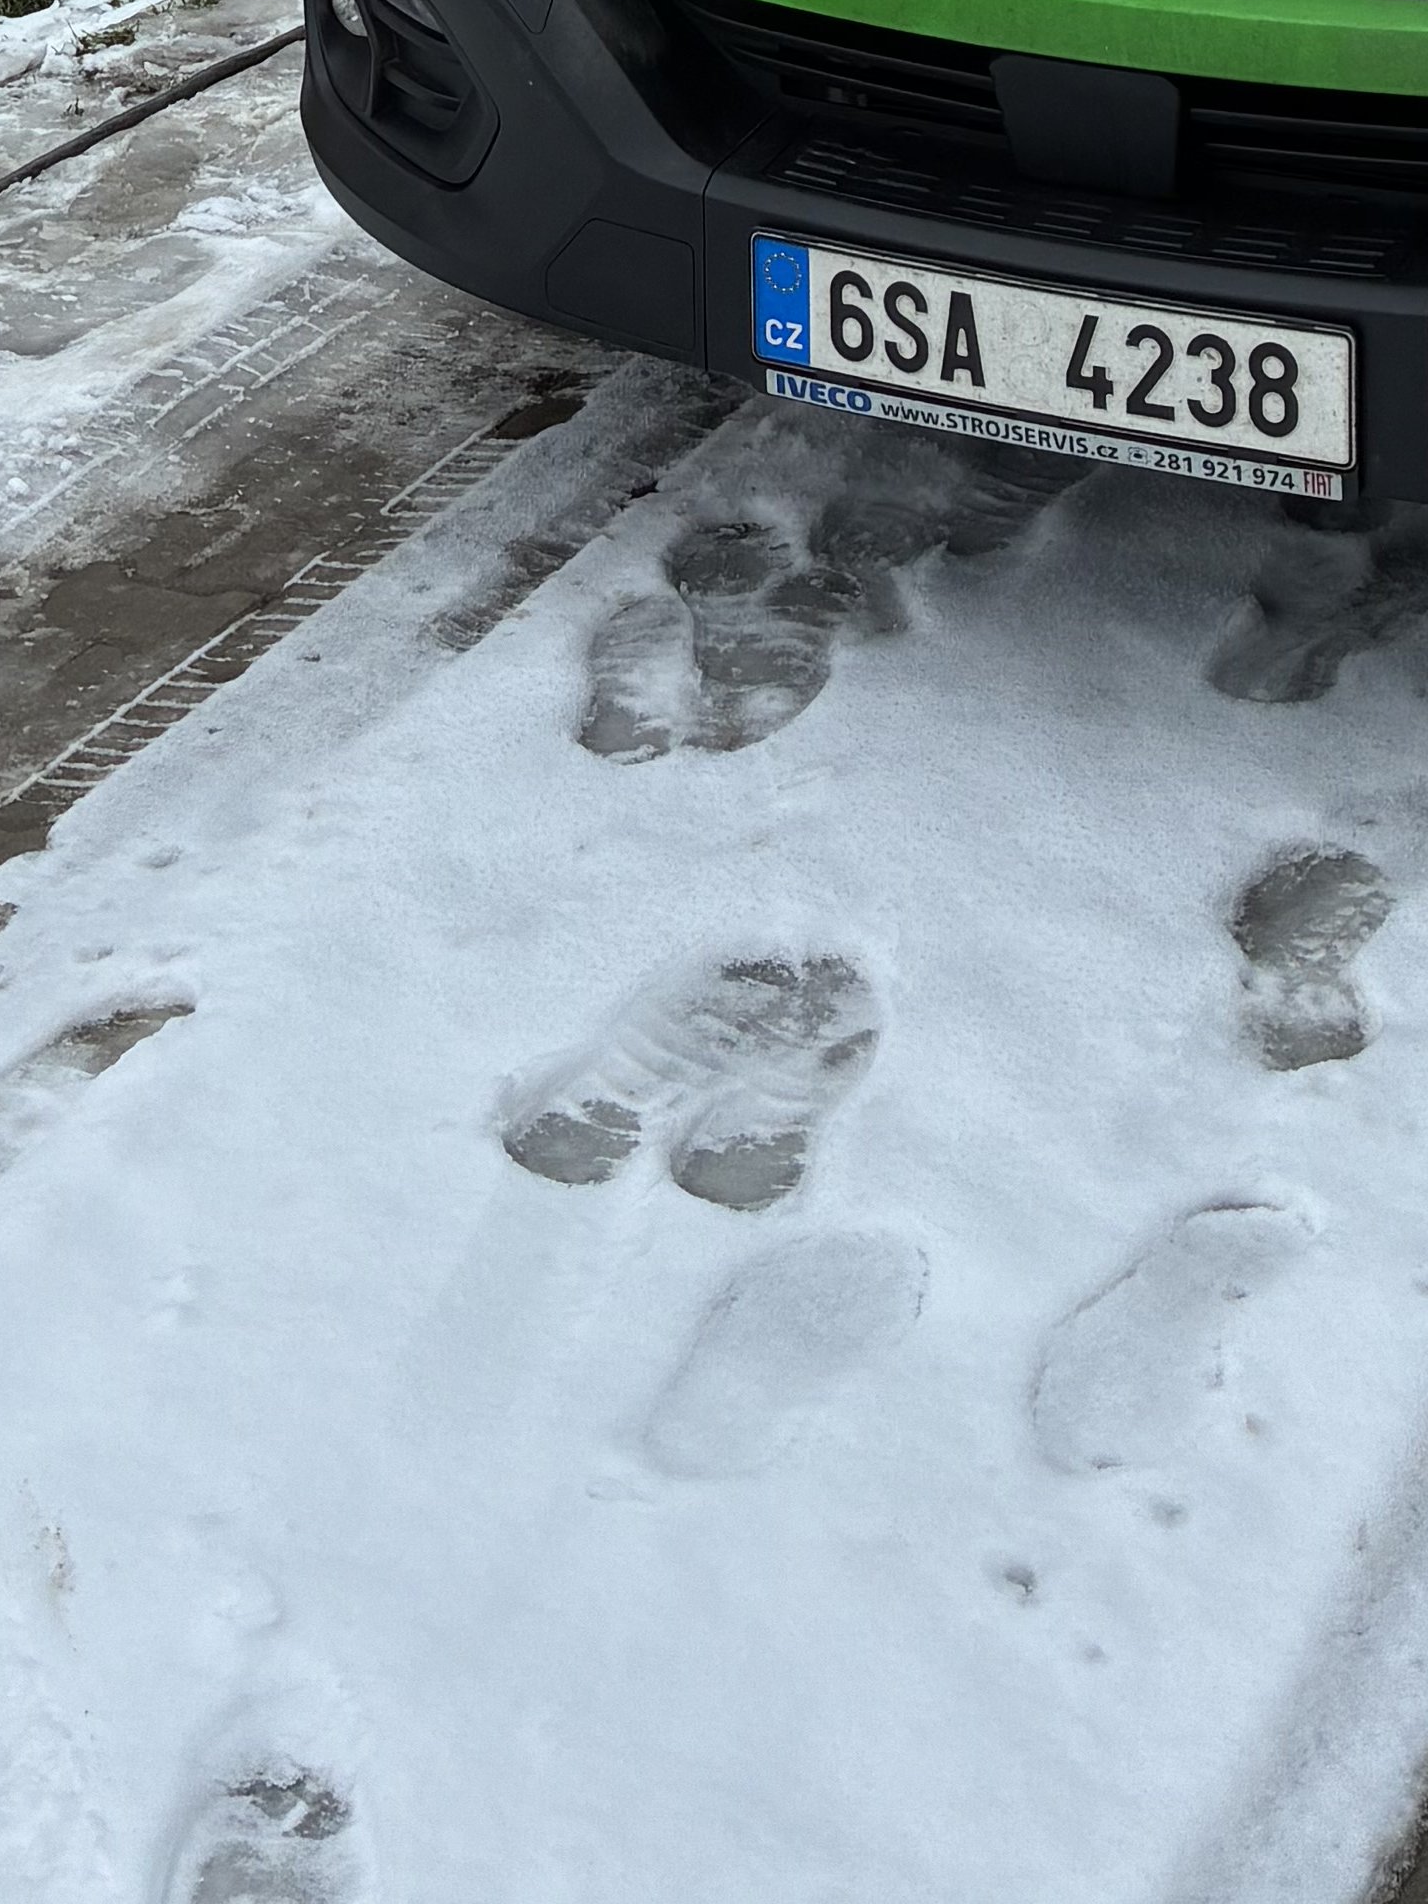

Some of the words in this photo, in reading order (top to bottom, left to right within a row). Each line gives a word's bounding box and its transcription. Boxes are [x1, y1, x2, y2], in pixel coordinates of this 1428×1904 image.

[764, 318, 804, 352] CZ
[829, 269, 986, 390] 6SA
[1065, 314, 1300, 438] 4238
[775, 373, 872, 413] IVECO
[1153, 450, 1194, 474] 281
[1202, 459, 1243, 482] 921
[1252, 468, 1296, 491] 974
[1303, 471, 1334, 498] FIAT
